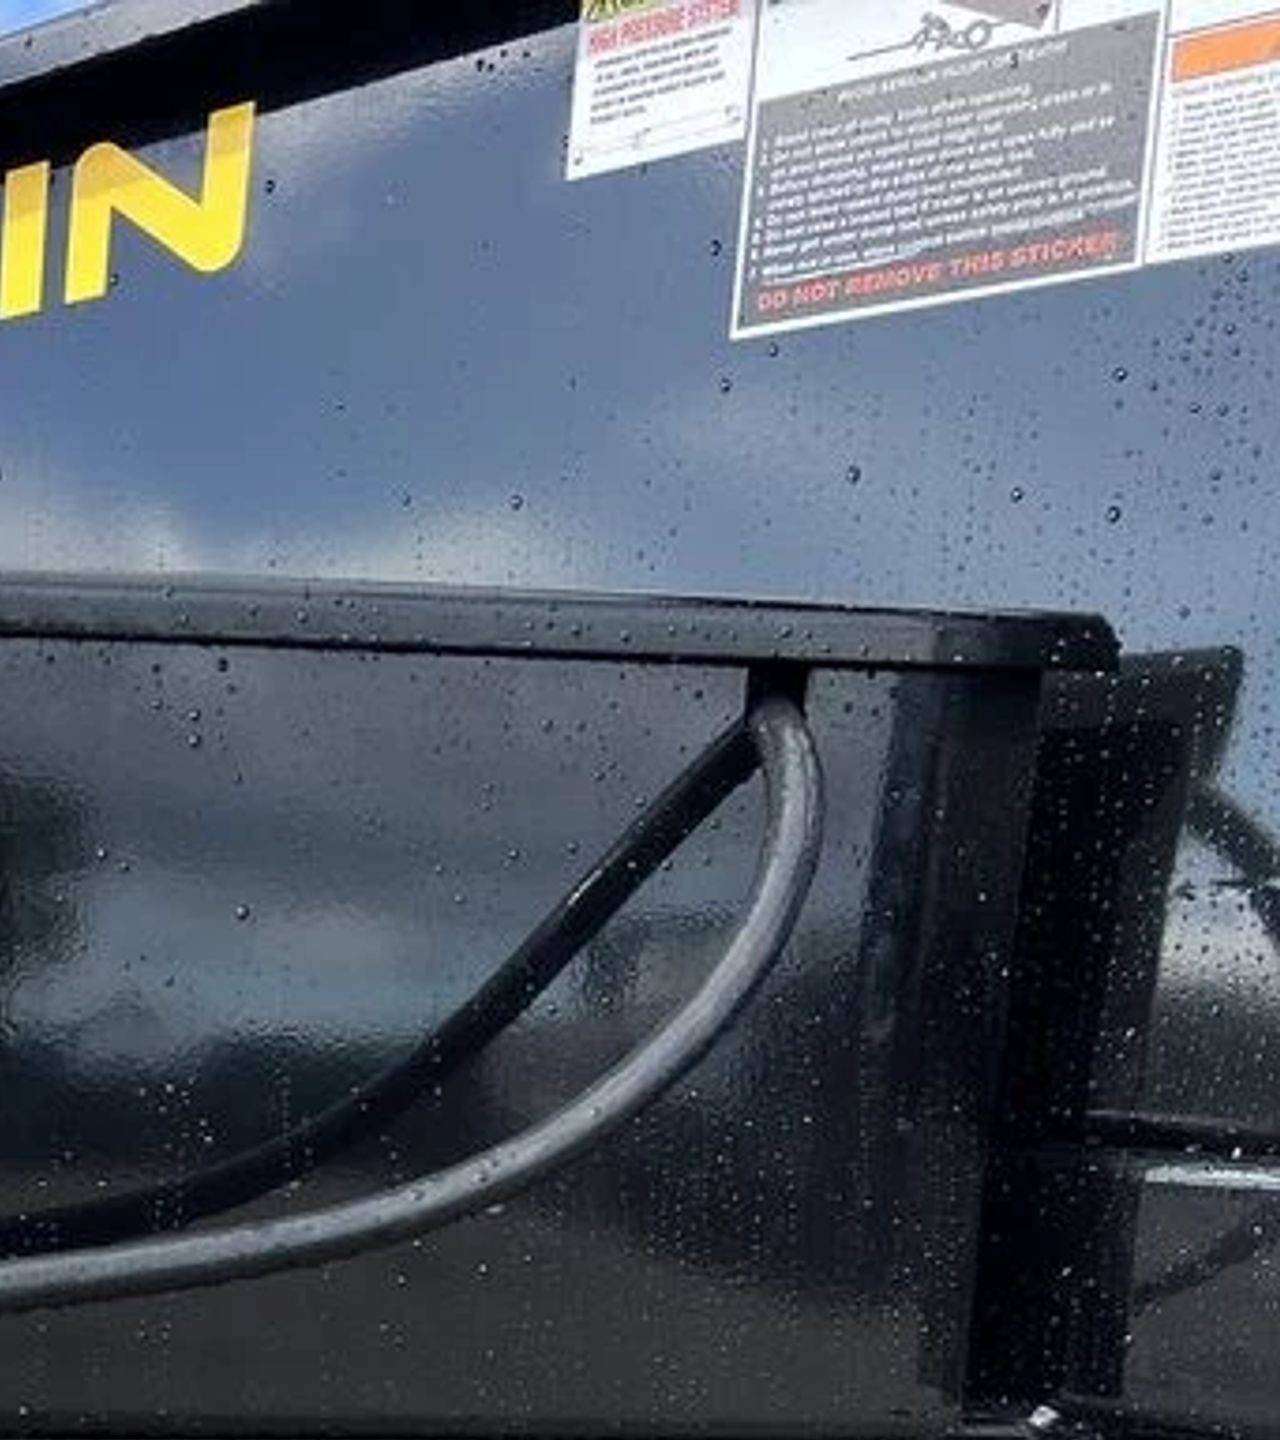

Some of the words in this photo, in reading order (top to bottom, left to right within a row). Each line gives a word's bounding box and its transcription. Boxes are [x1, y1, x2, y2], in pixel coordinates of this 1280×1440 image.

[757, 288, 786, 310] DO
[792, 278, 838, 306] NOT
[845, 259, 939, 296] REMOVE
[949, 250, 1004, 278] THIS
[1010, 229, 1119, 269] STICKER
